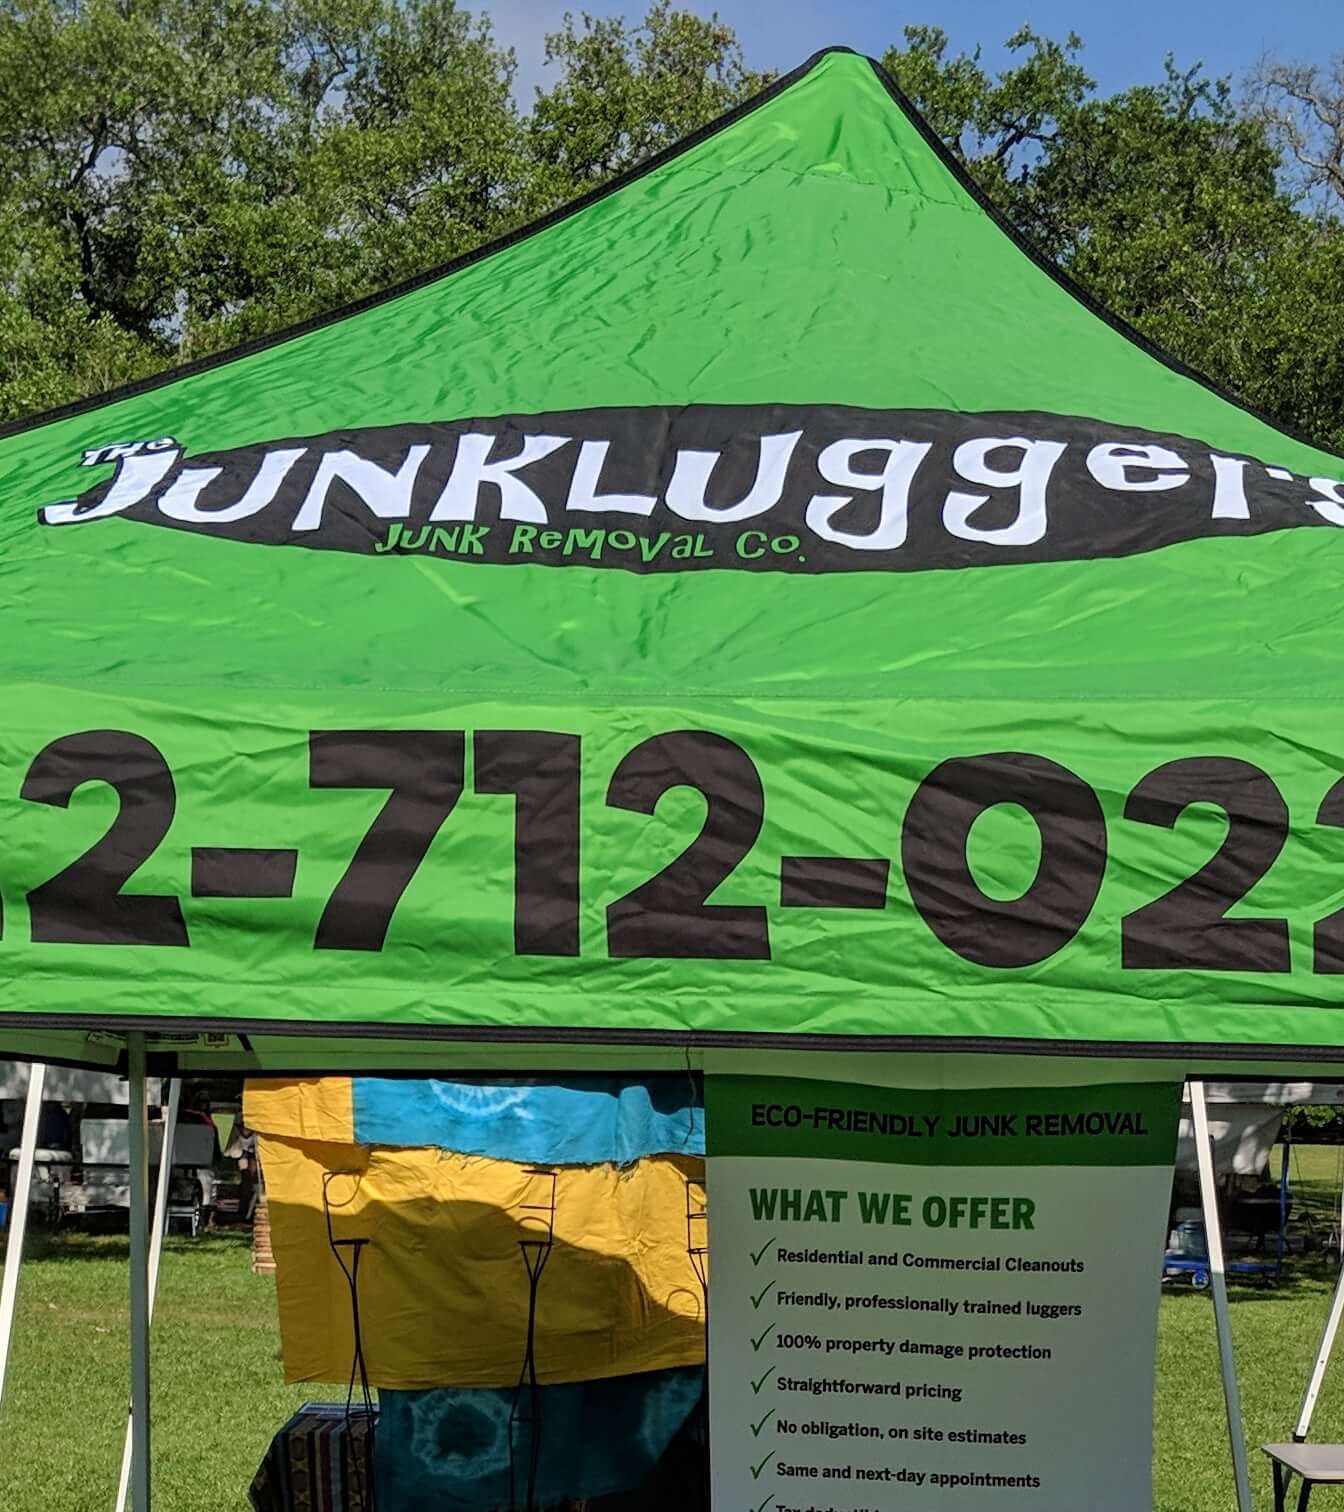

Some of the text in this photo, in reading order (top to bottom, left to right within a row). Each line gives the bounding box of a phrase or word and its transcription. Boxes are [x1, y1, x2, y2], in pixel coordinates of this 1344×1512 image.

[374, 523, 491, 555] JUNK
[751, 1104, 1148, 1137] ECO-FRIENDLY JUNK REMOVAL
[748, 1188, 1035, 1230] WHAT WE OFFER
[777, 1248, 1084, 1273] Residential and Commercial Cleanouts
[777, 1291, 1082, 1319] Friendly, professionally trained luggers
[776, 1334, 1052, 1360] 100% property damage protection
[777, 1377, 962, 1402] Straightforward pricing
[777, 1420, 1026, 1445] No obligation, on site estimates
[776, 1462, 1041, 1489] Same and next-day appointments
